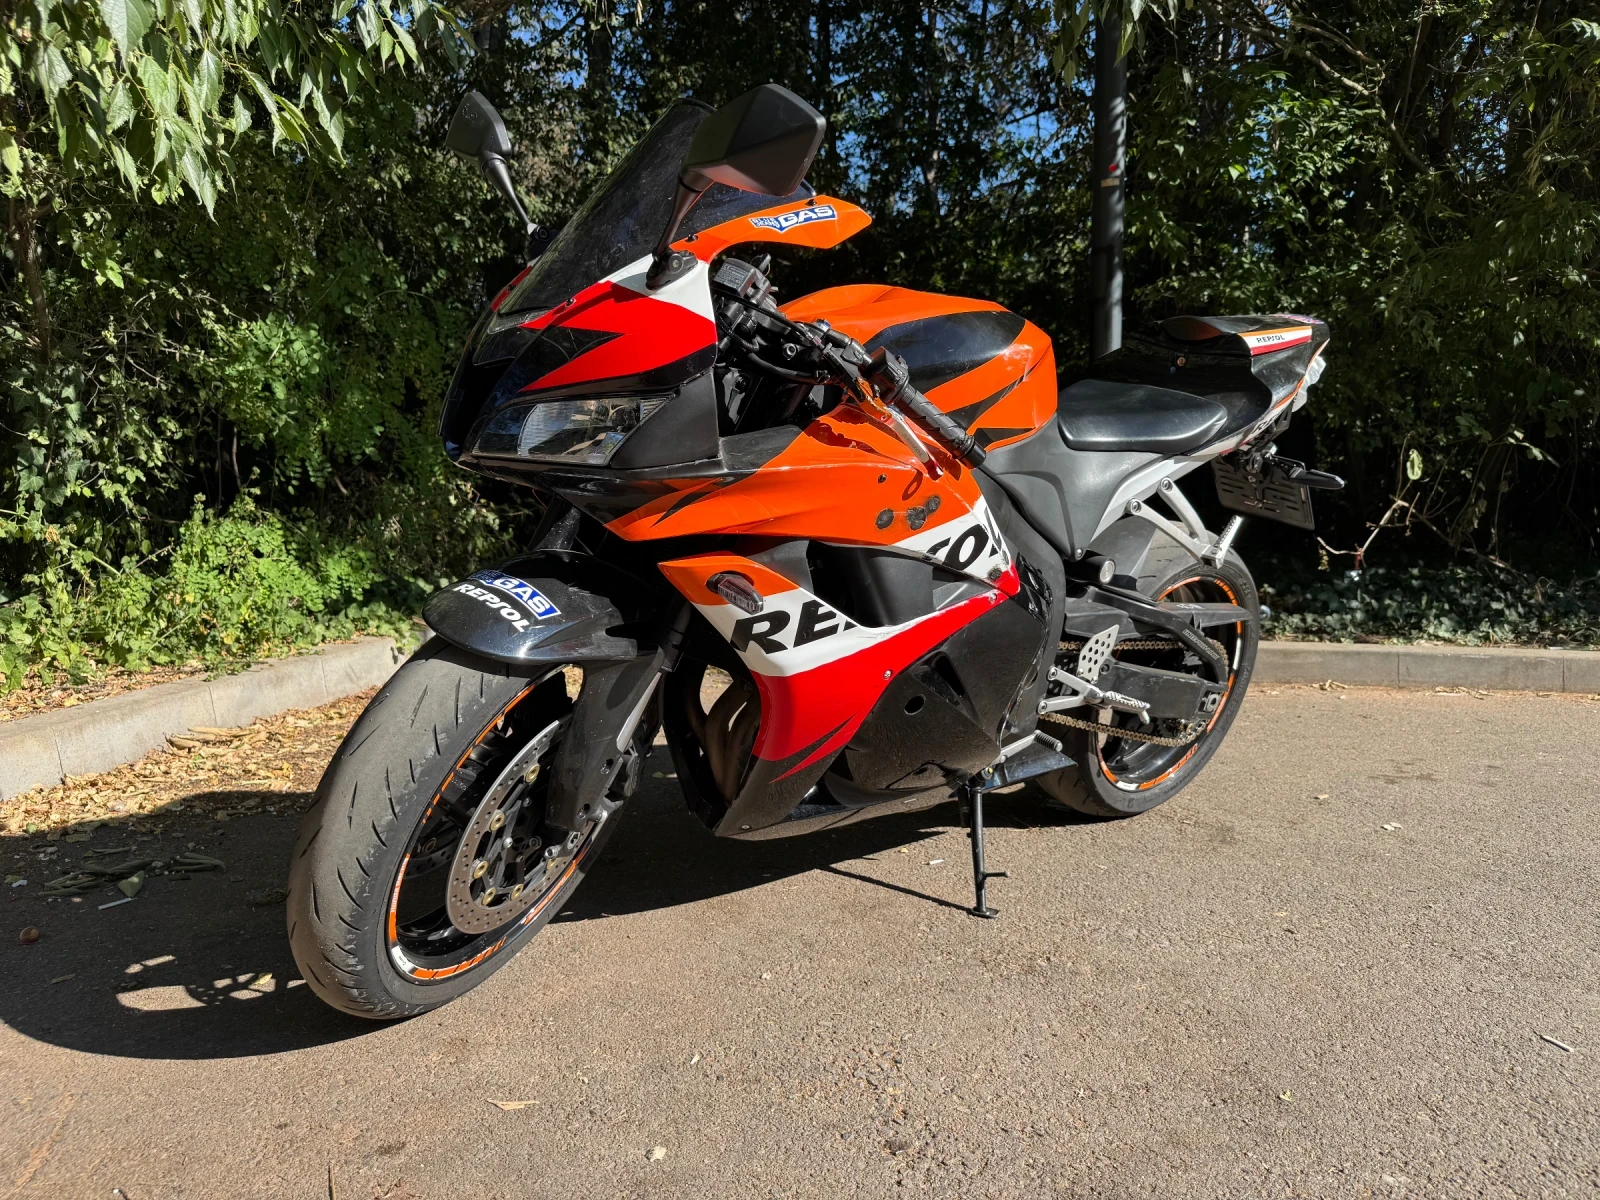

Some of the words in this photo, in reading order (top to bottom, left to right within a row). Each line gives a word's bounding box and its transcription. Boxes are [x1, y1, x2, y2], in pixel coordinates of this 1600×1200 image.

[777, 206, 833, 227] GAS
[1256, 334, 1286, 344] REPSOL
[452, 584, 530, 632] REPSOL
[492, 578, 551, 614] GAS
